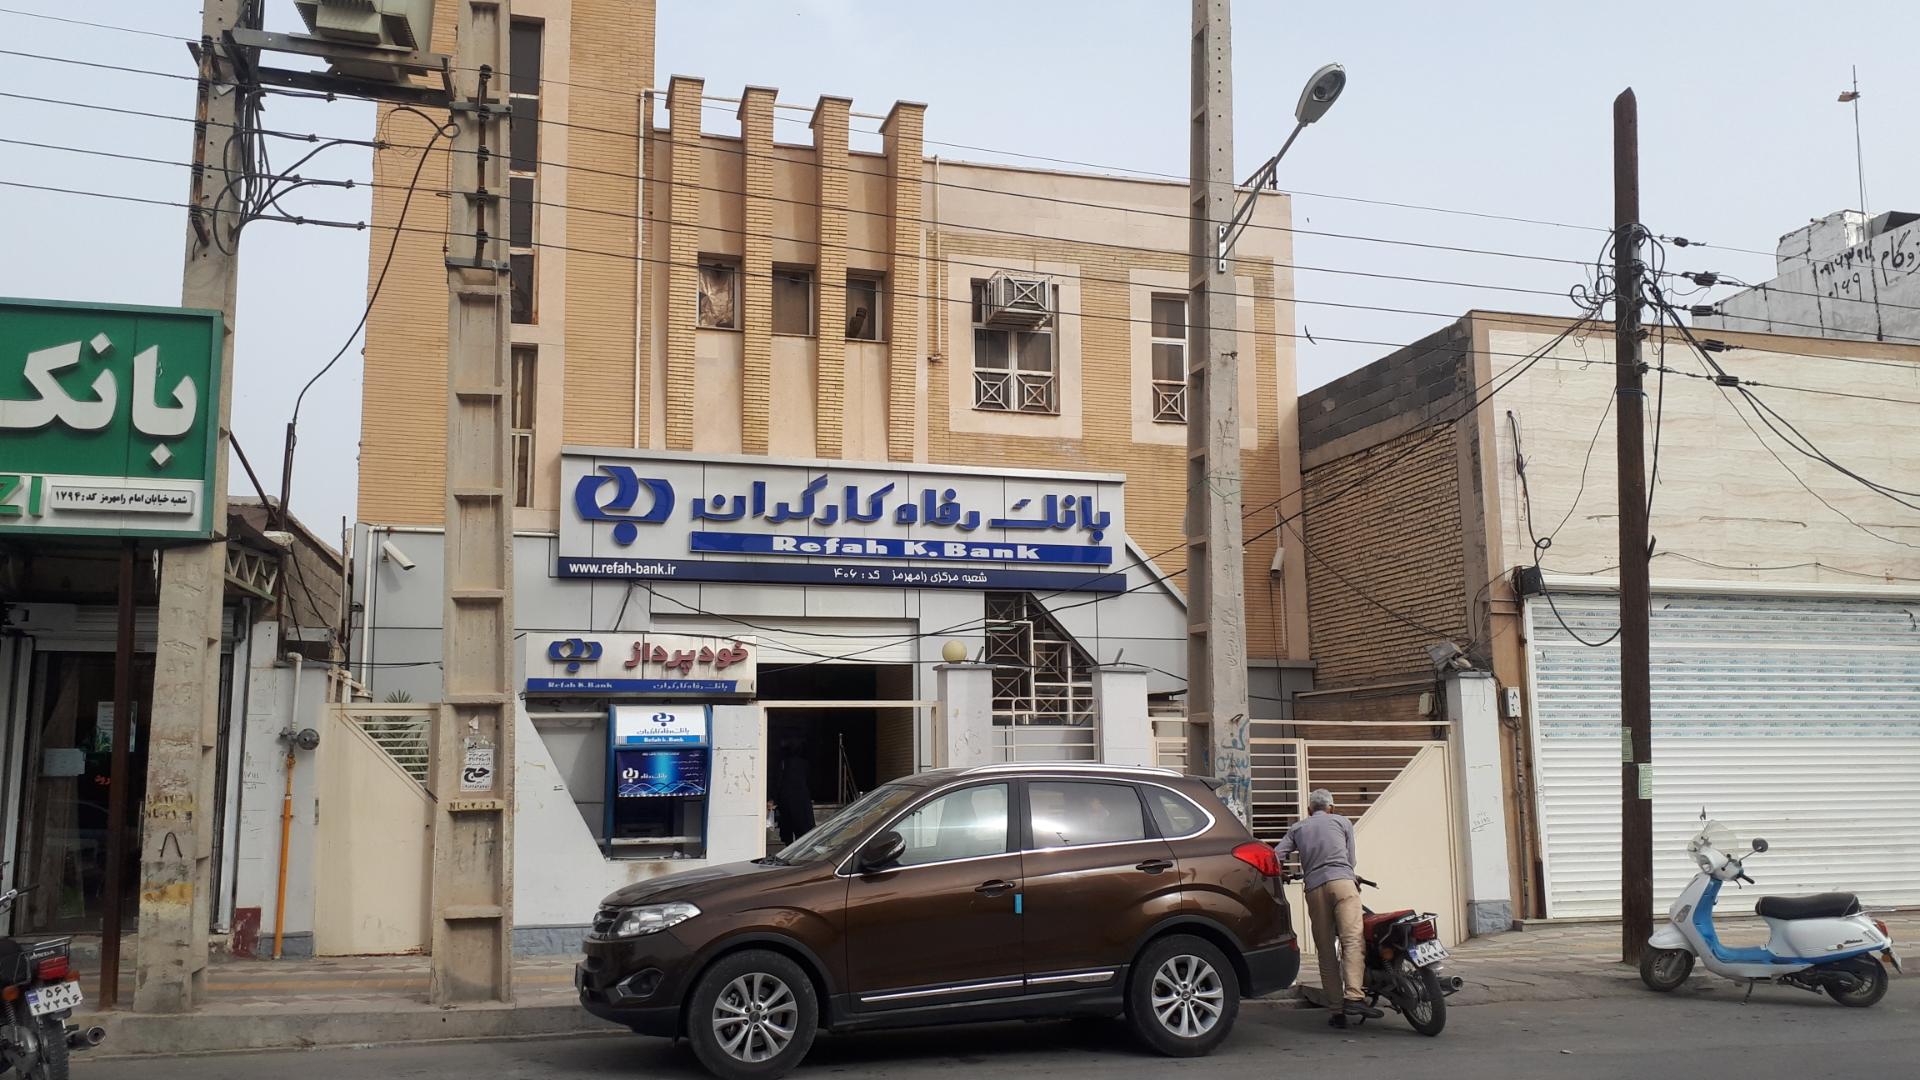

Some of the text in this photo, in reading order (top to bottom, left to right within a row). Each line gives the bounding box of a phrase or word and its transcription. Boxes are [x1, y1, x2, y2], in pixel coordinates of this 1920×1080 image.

[128, 493, 144, 505] امام
[691, 472, 1111, 542] بانک رفاه کارگران
[772, 536, 888, 556] Refah
[569, 562, 677, 576] www.refah-bank.ir
[891, 569, 928, 582] رامهرمز
[930, 570, 959, 583] مرکزی
[961, 571, 988, 584] شعبه
